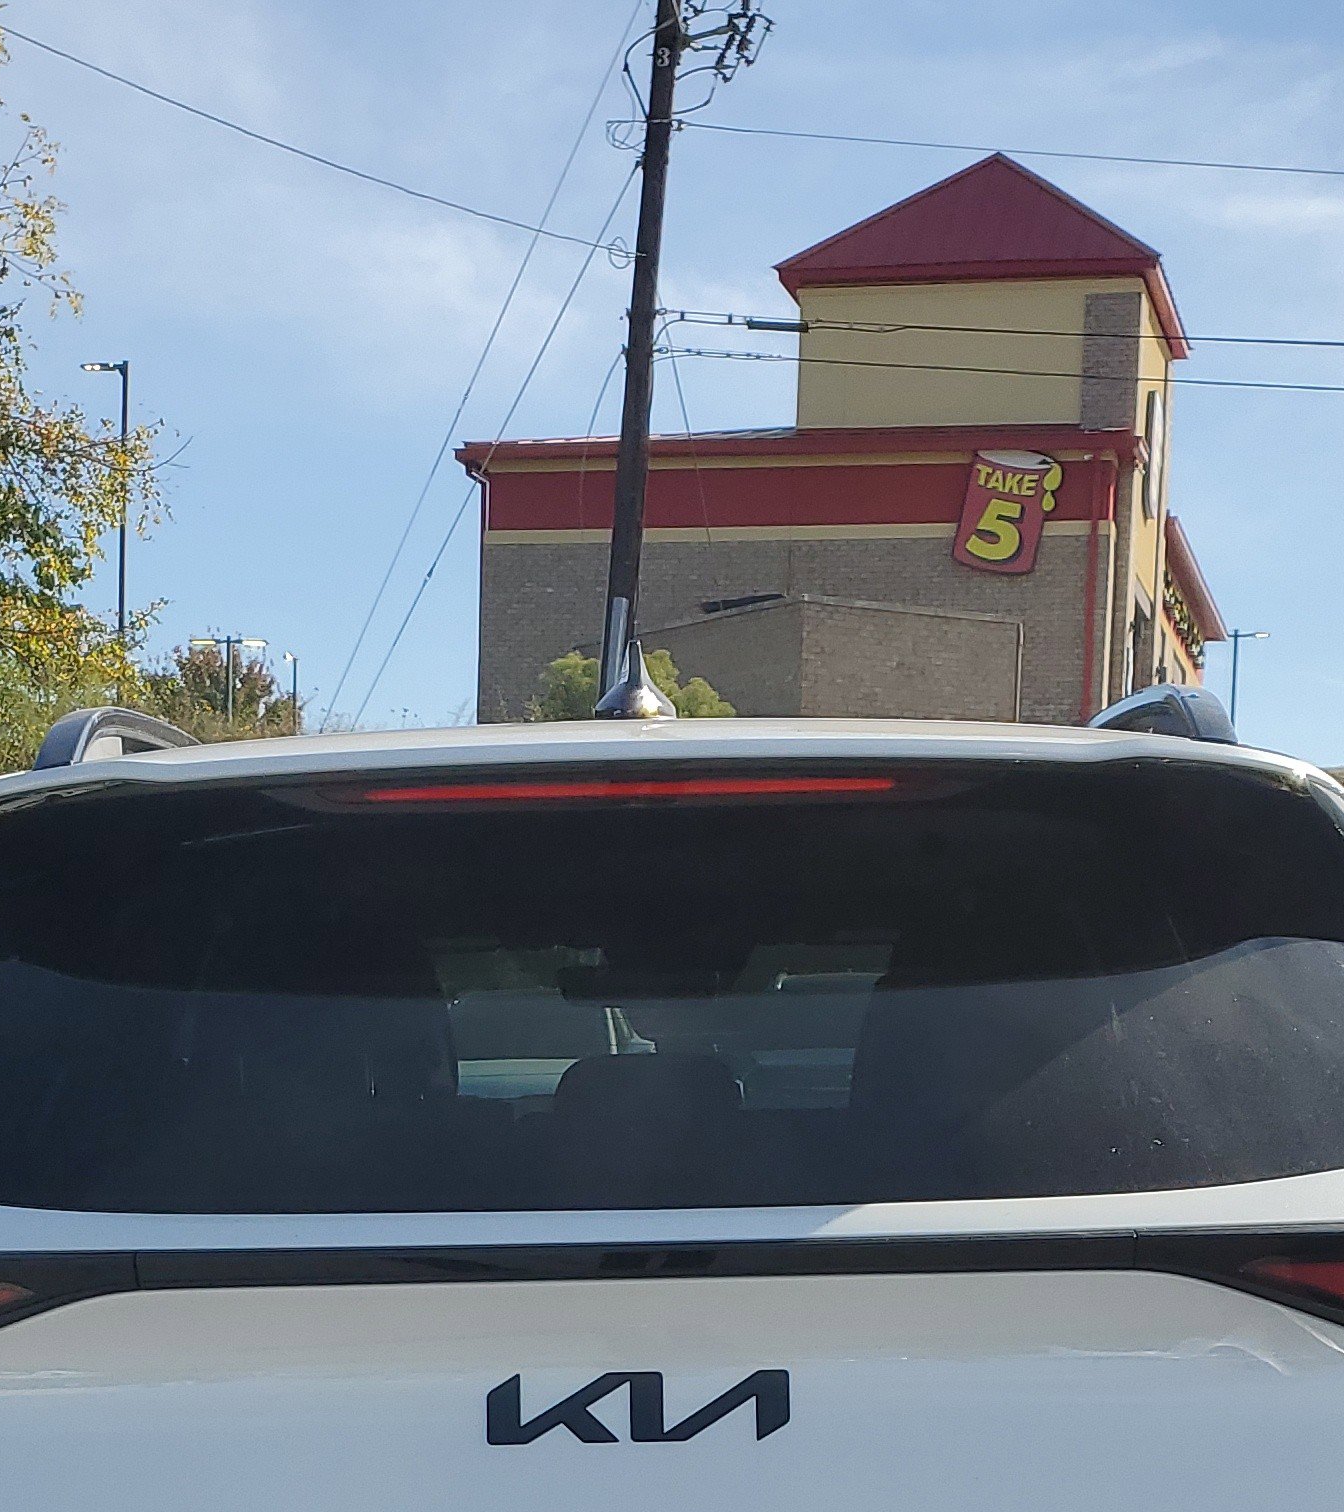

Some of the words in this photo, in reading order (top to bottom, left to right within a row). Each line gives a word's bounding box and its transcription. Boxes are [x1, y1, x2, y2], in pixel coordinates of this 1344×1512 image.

[976, 463, 1039, 496] TAKE
[965, 498, 1020, 560] 5
[486, 1369, 791, 1446] KIA
